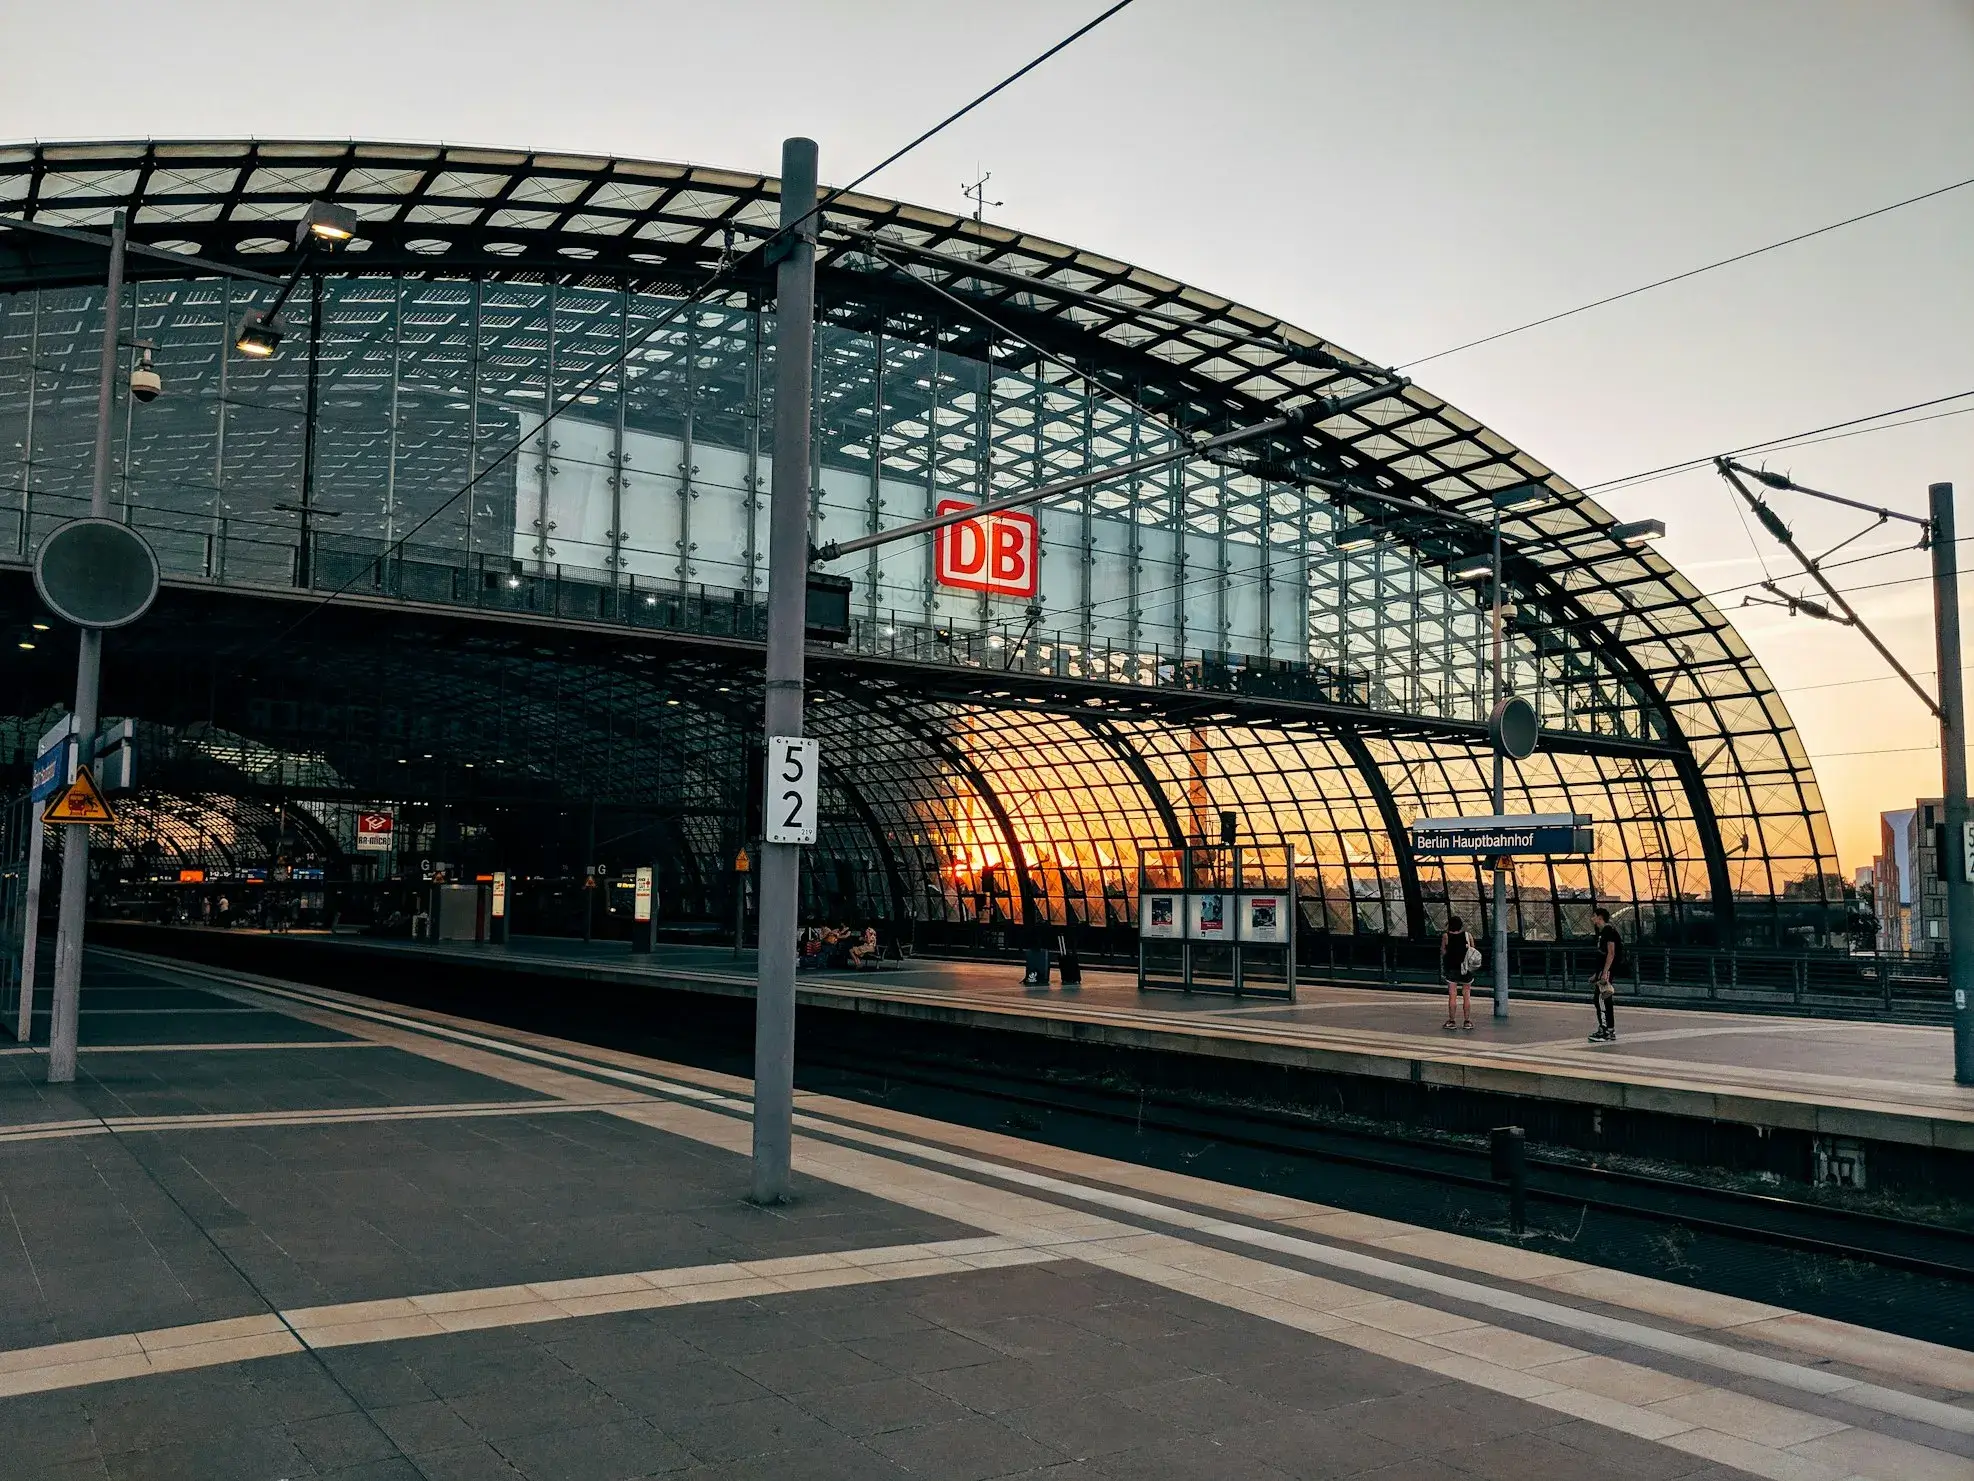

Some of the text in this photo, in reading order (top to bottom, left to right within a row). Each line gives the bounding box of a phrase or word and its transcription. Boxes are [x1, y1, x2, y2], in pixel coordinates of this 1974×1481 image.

[950, 518, 1025, 581] DB
[782, 746, 803, 782] 5
[782, 791, 802, 827] 2
[1417, 832, 1534, 850] Berlin Hauptbahnhof
[421, 859, 430, 871] G
[598, 864, 606, 874] G
